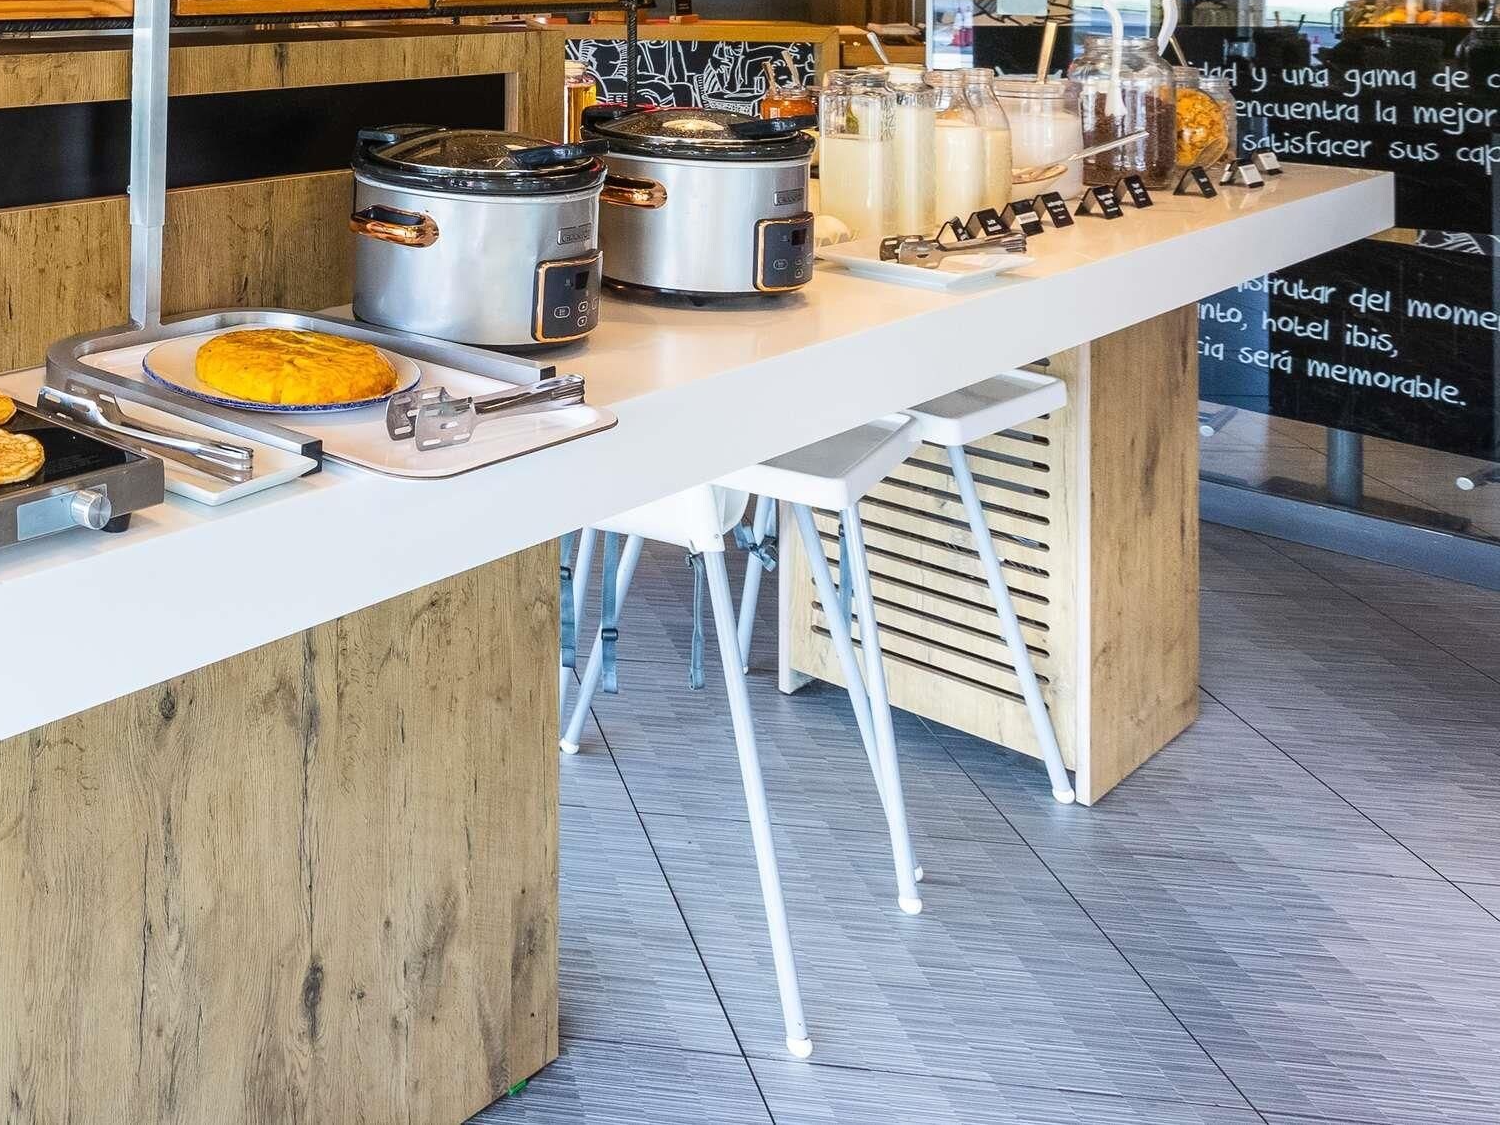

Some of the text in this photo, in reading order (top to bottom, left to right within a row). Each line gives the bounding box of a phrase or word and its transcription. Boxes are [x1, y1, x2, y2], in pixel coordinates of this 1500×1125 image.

[1252, 66, 1266, 92] y
[1282, 65, 1329, 87] una
[1343, 67, 1416, 97] gama
[1431, 65, 1471, 92] de
[1375, 100, 1397, 124] la
[1413, 102, 1498, 135] mejor
[1242, 131, 1372, 158] satisfacer
[1389, 141, 1440, 161] sus
[1349, 287, 1391, 313] del
[1262, 311, 1329, 341] hotel
[1345, 324, 1399, 358] ibis,
[1238, 345, 1293, 374] será
[1307, 358, 1467, 407] memorable.
